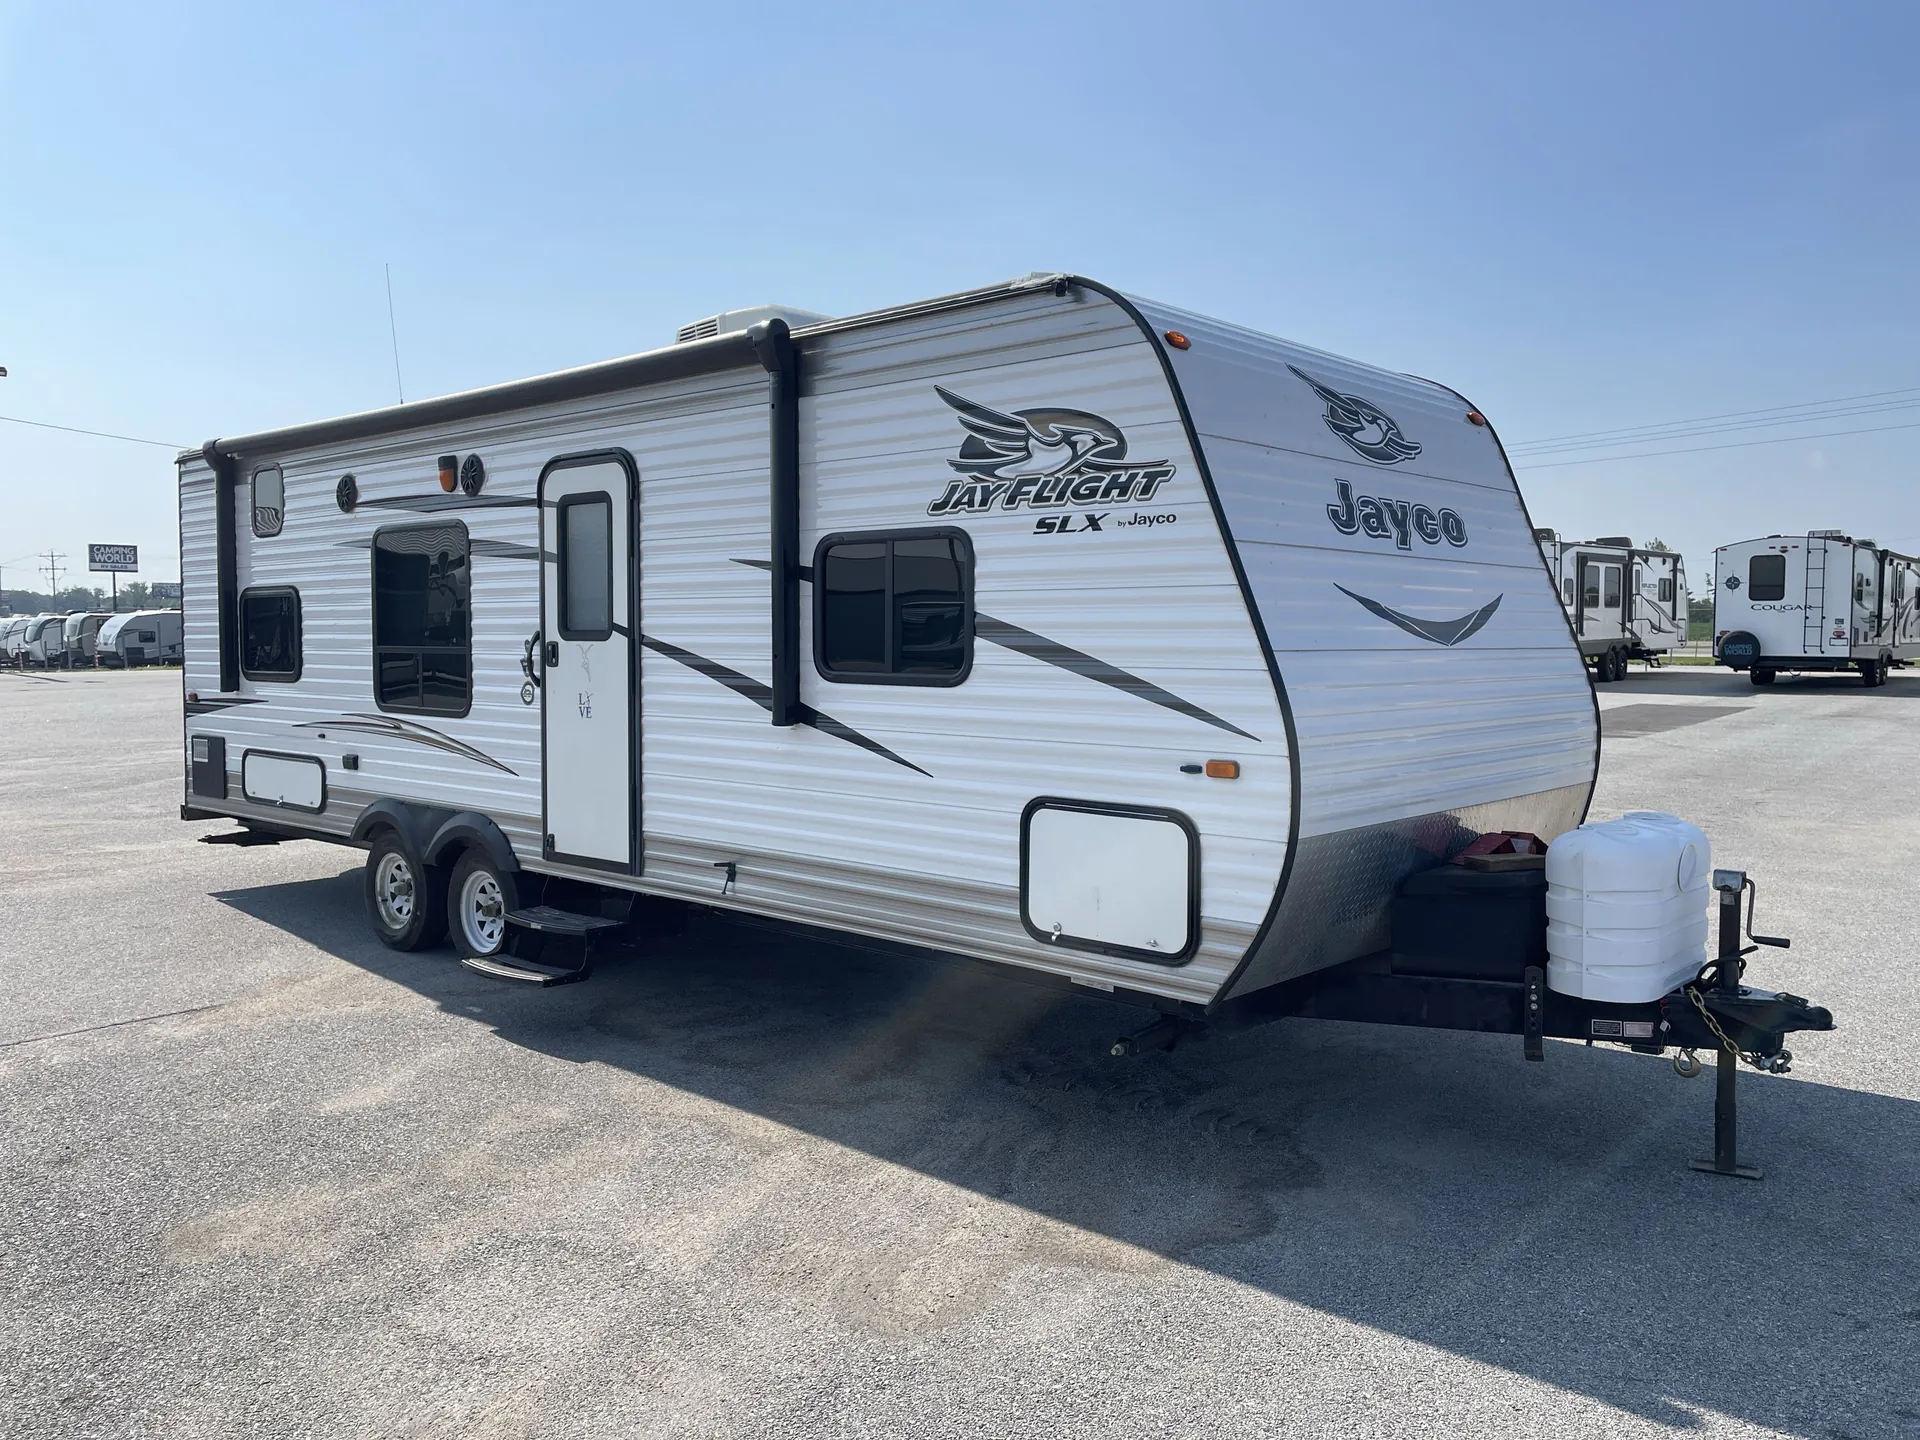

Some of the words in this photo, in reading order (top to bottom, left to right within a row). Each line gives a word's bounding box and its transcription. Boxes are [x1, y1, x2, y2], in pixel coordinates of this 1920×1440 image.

[1326, 478, 1468, 551] Jayco
[1033, 513, 1111, 535] SLX
[1117, 520, 1127, 528] by
[1127, 513, 1177, 528] Jayco
[93, 546, 134, 554] CAMPING
[94, 554, 134, 562] WORLD
[1750, 603, 1813, 611] COUGAR
